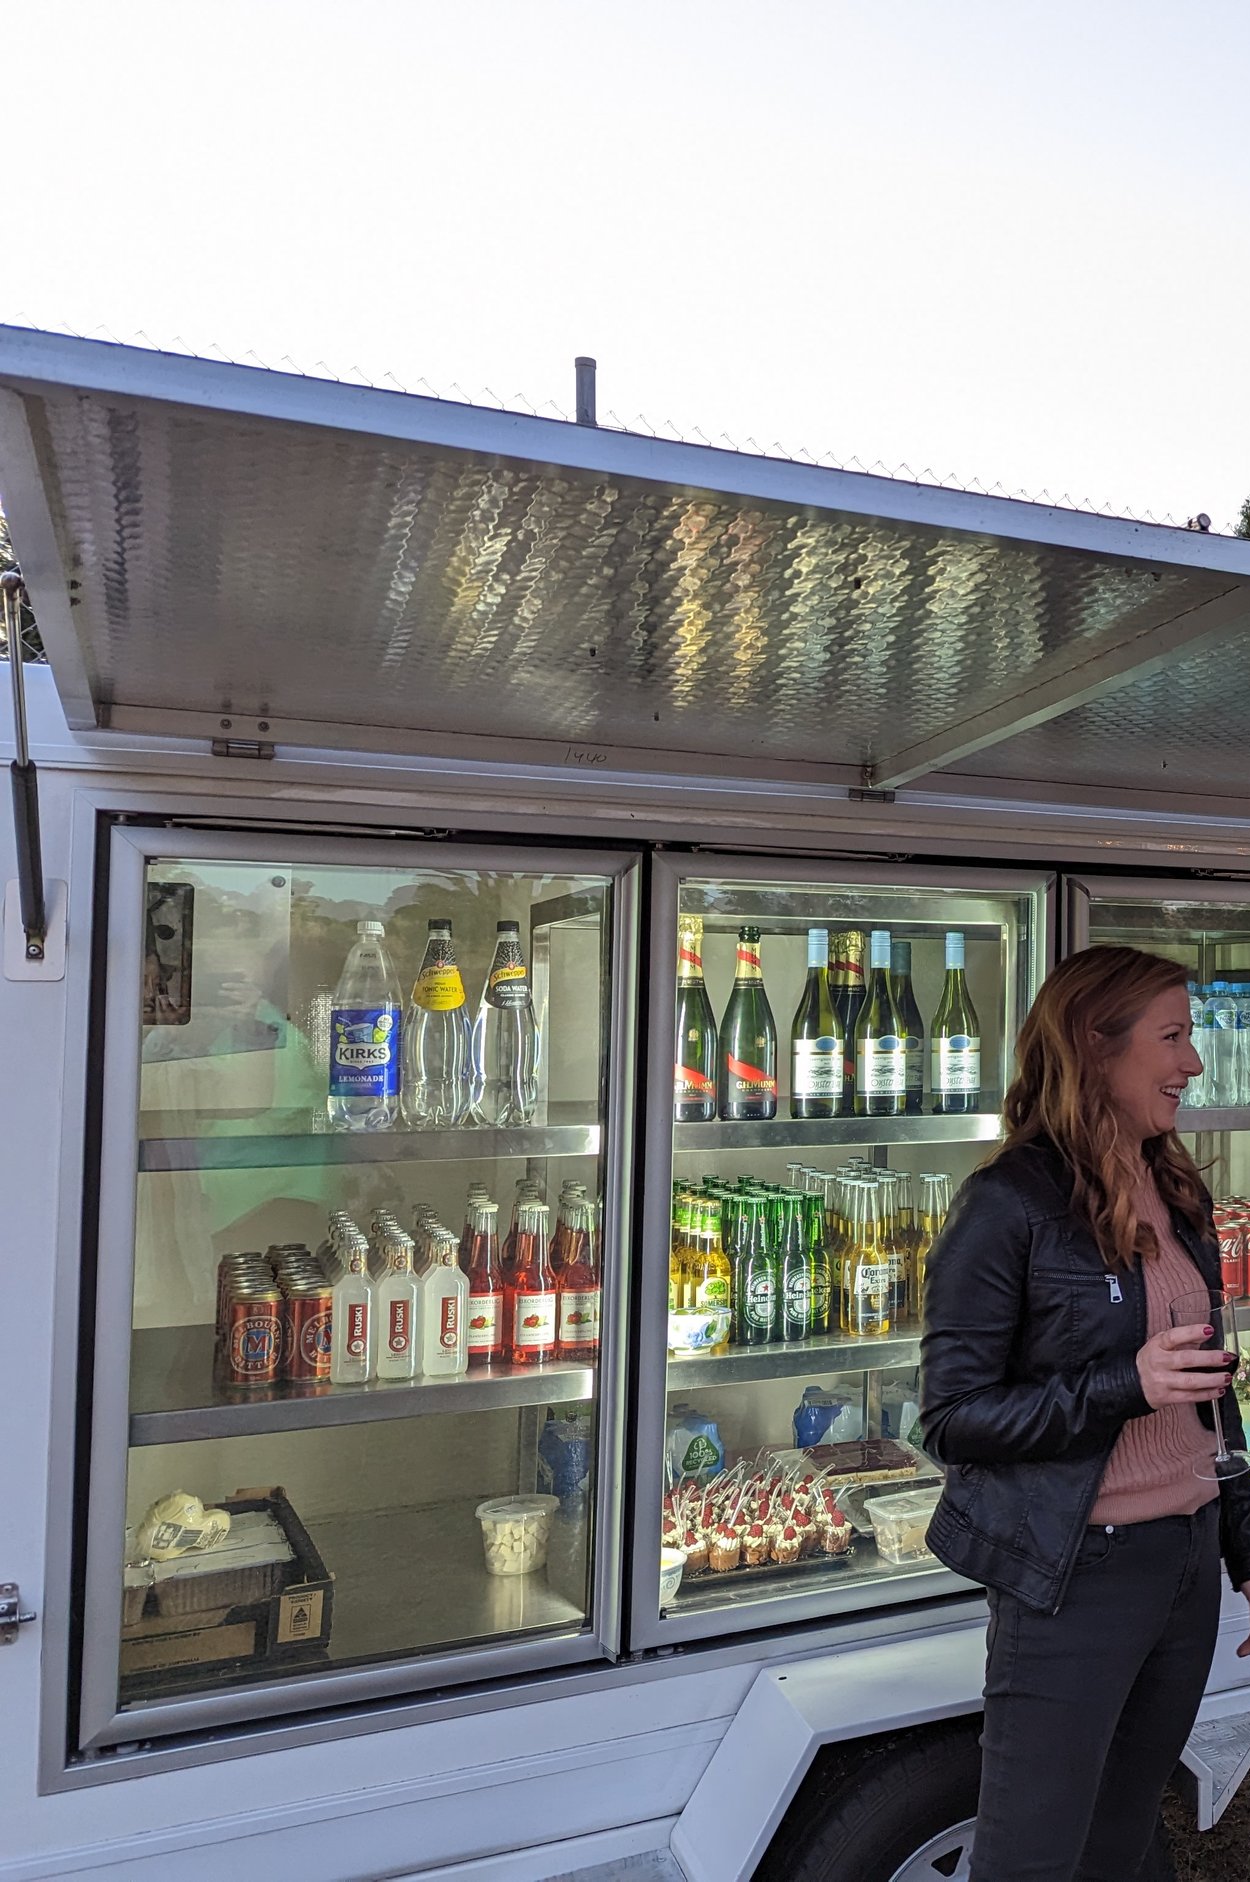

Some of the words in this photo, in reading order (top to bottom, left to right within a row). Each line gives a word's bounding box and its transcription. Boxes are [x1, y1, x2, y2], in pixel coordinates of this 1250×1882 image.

[338, 1047, 388, 1061] KIRKS
[338, 1075, 385, 1083] LEMONADE
[353, 1306, 363, 1336] RUSKI
[395, 1303, 404, 1333] RUSKI
[446, 1299, 456, 1329] RUSKI
